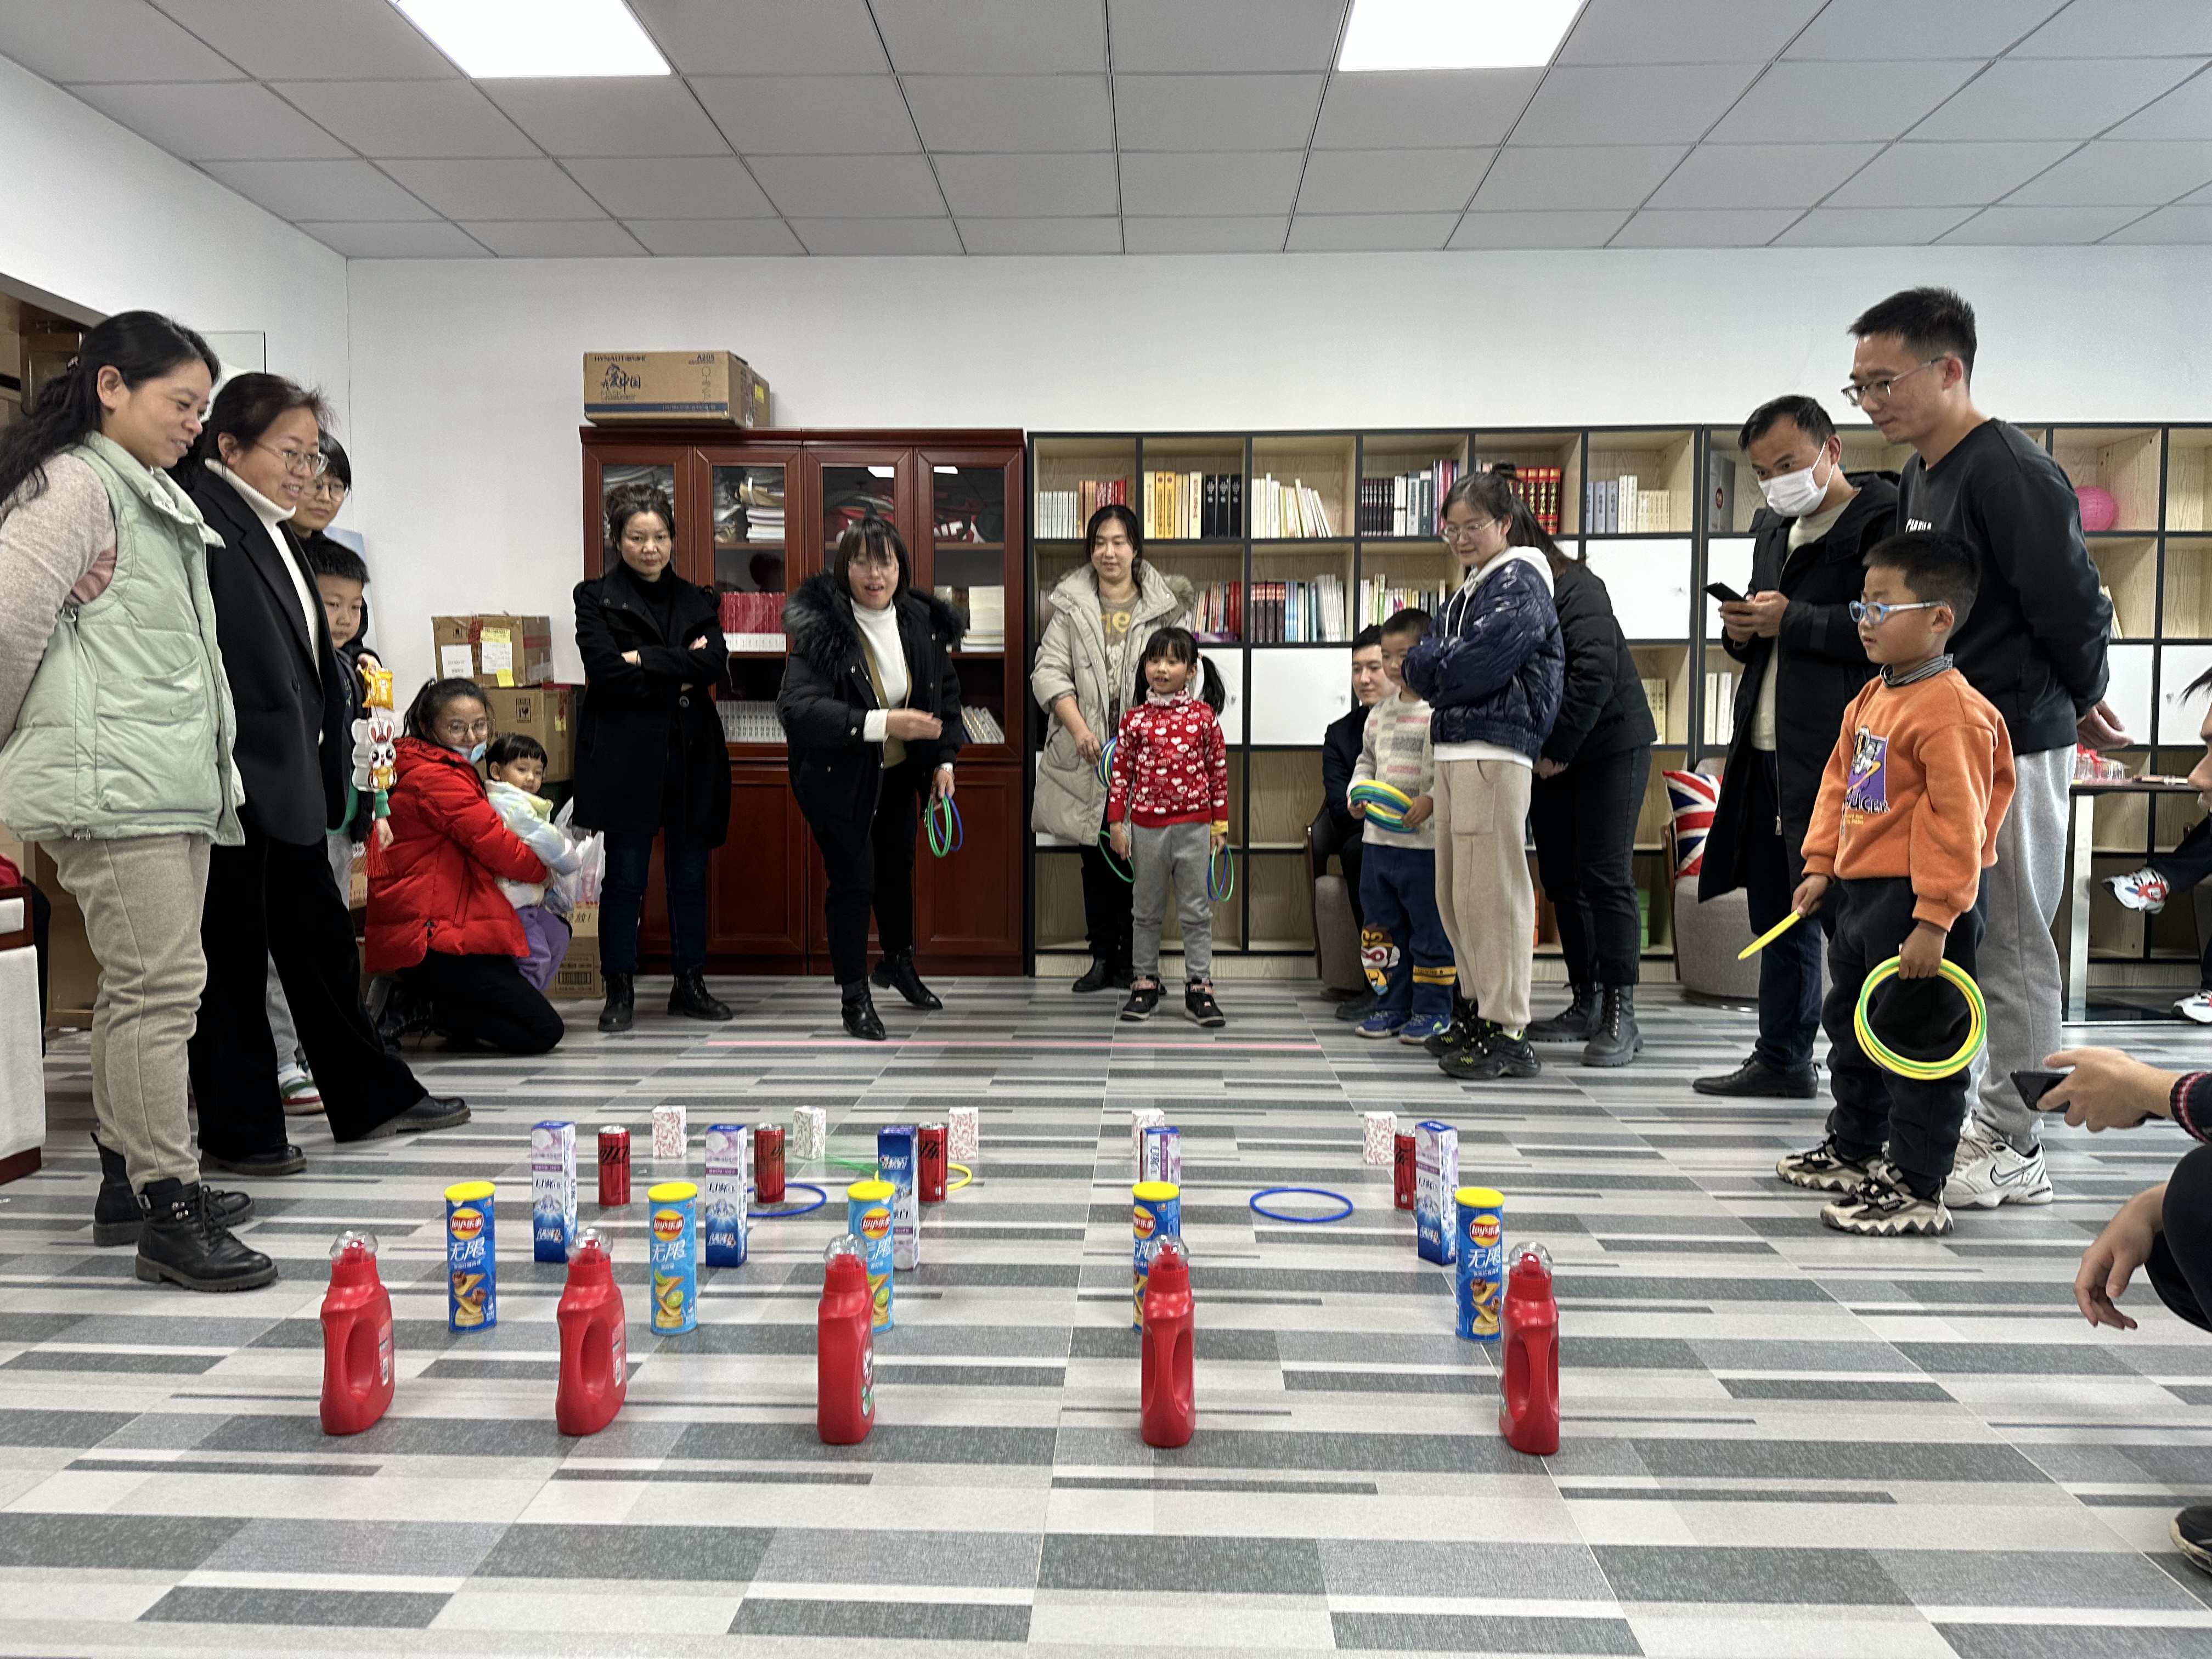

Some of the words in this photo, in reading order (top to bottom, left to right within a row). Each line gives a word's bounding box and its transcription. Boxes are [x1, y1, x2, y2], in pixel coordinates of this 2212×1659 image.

[450, 1237, 486, 1261] 无限
[651, 1239, 686, 1263] 无限
[1468, 1244, 1502, 1269] 无限
